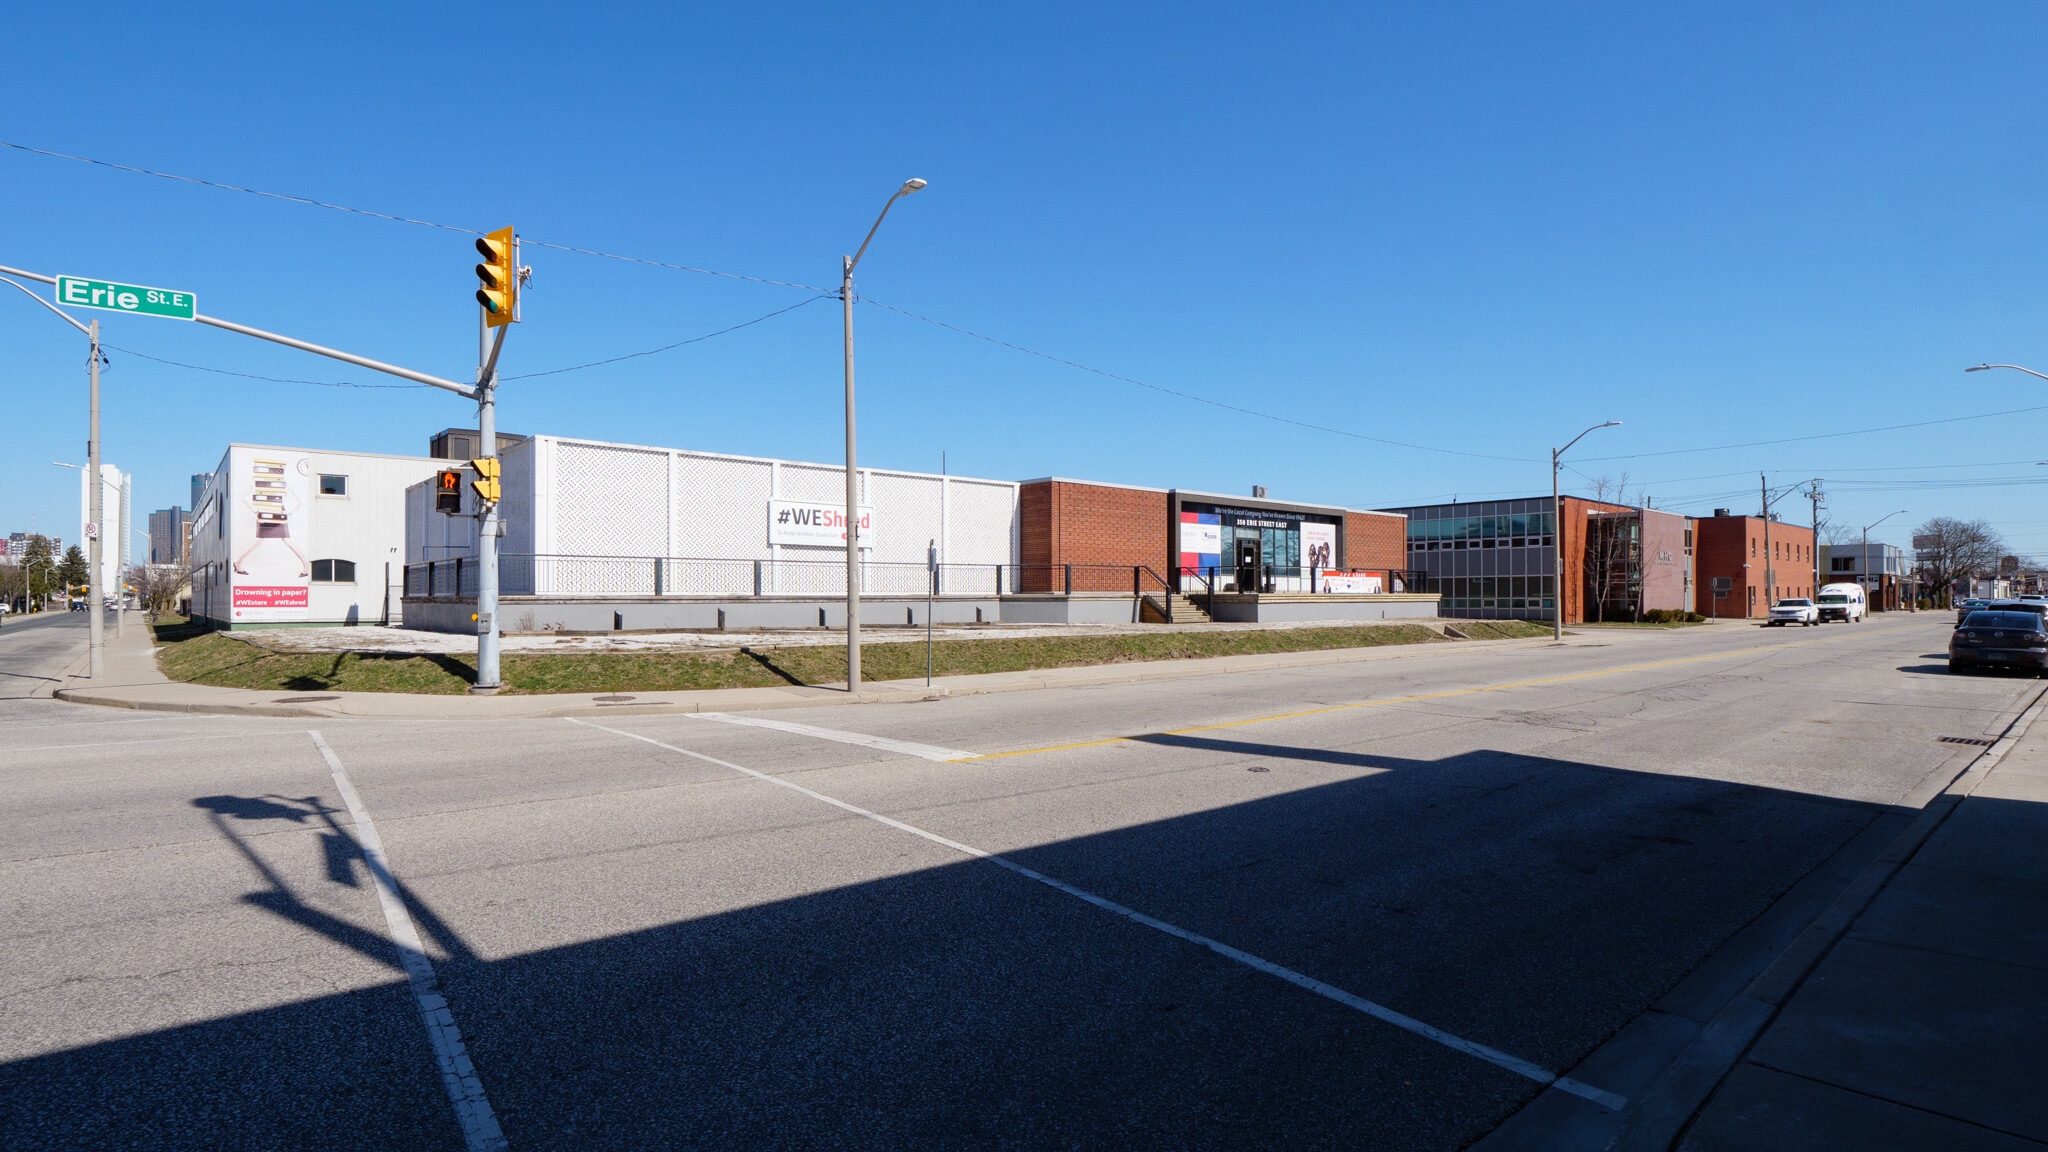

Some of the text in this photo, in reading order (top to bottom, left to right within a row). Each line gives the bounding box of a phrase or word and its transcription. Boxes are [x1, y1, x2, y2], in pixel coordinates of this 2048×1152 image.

[65, 279, 188, 309] Erie St. E.
[777, 508, 870, 528] #WEShrd
[1245, 510, 1262, 518] Company
[1246, 519, 1258, 527] ERIE
[1258, 520, 1275, 528] STREET
[235, 589, 272, 597] Drowning
[282, 589, 307, 597] paper?
